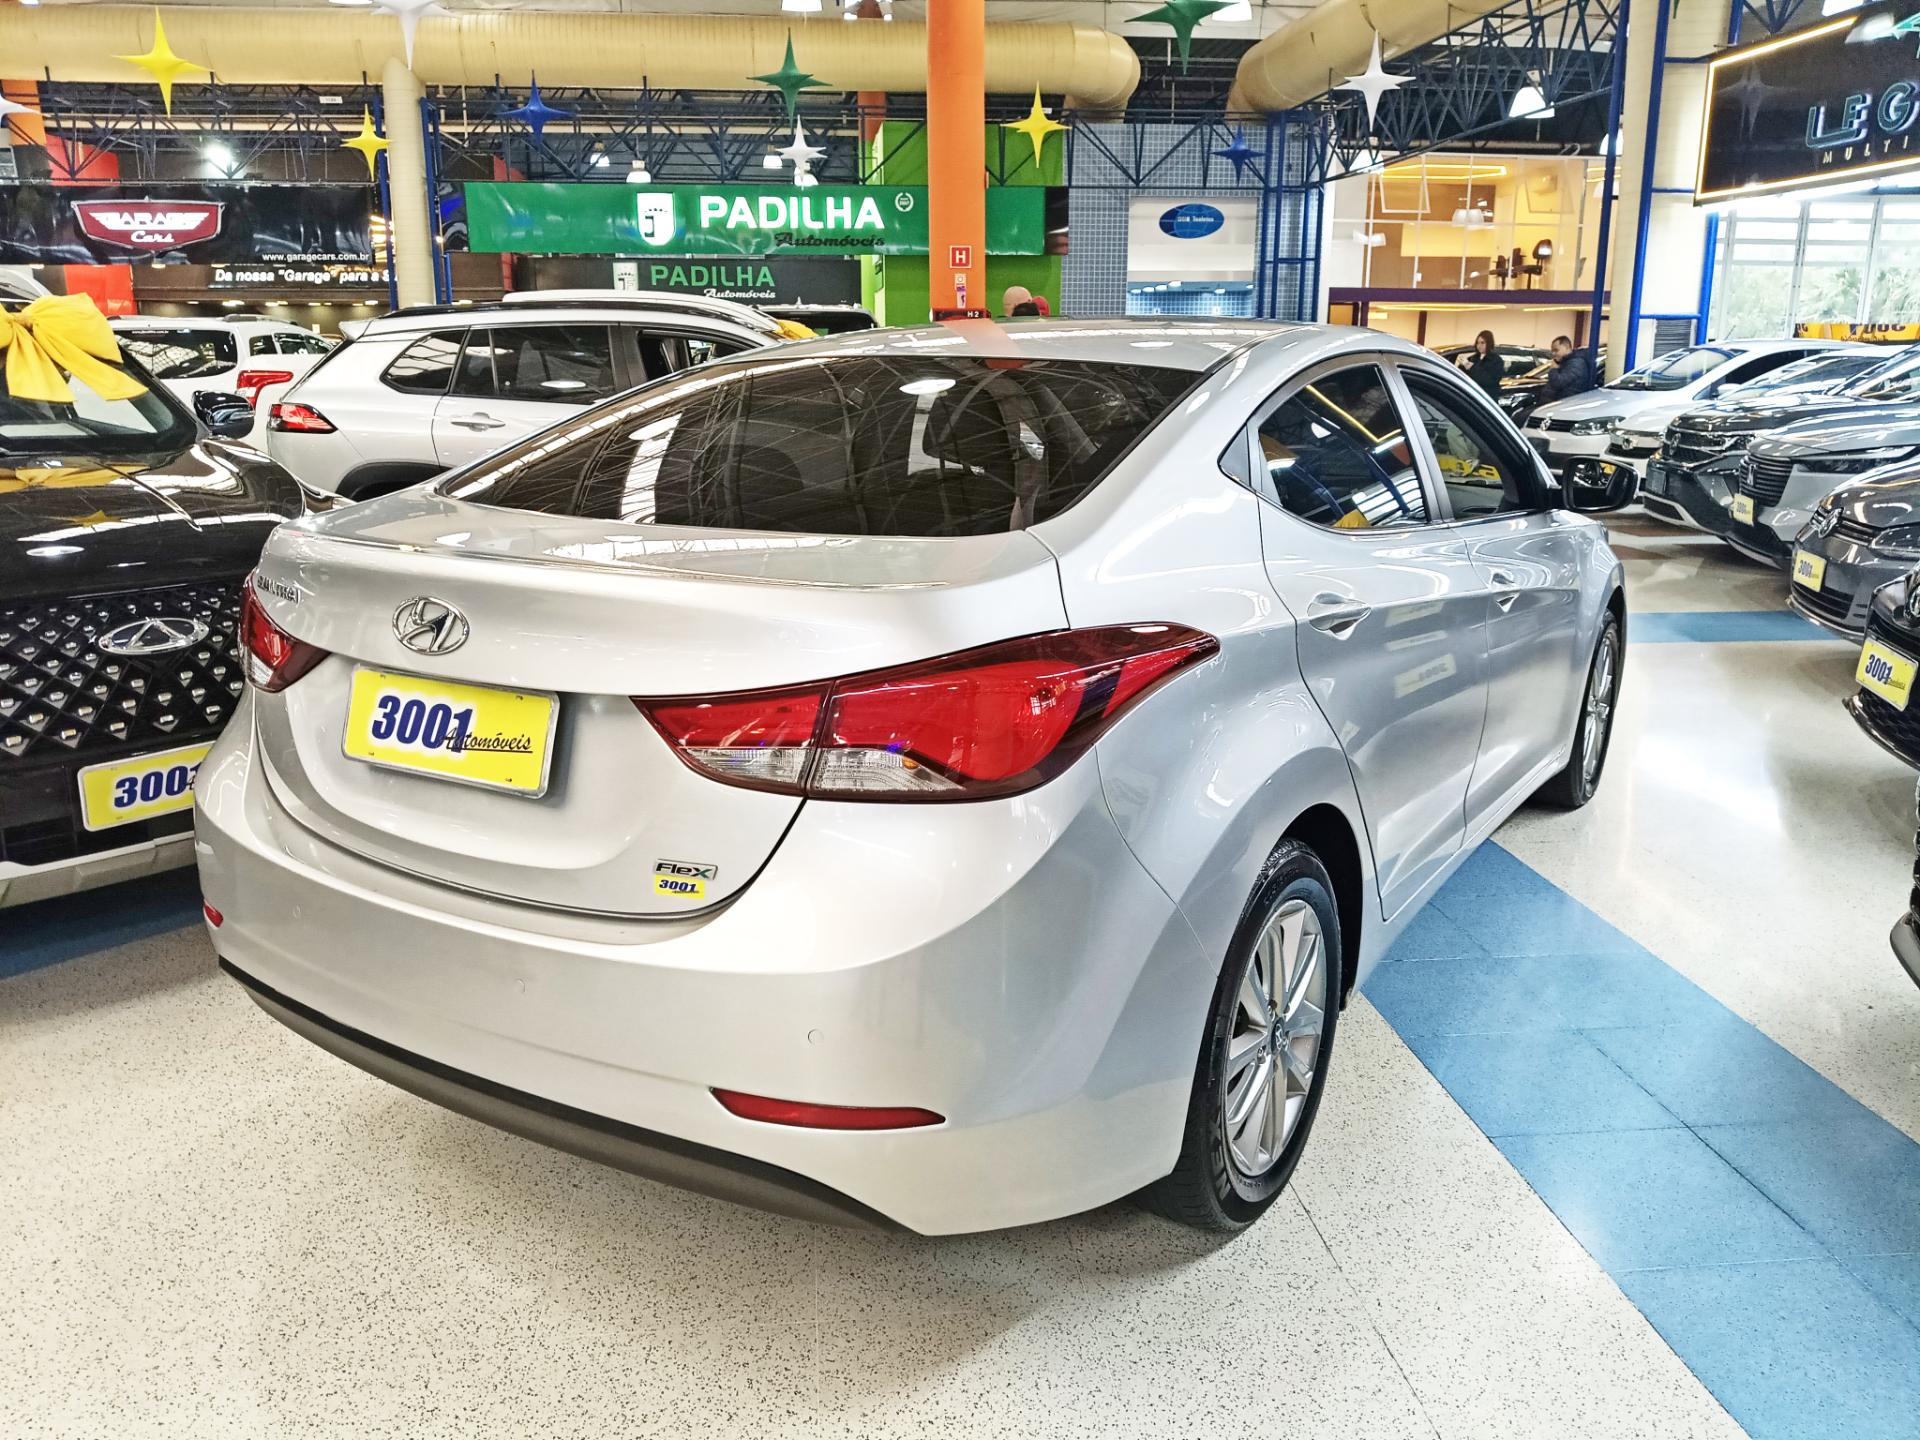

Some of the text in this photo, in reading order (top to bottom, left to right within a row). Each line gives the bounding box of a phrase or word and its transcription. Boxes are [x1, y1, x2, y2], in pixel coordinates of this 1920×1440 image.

[1822, 135, 1909, 164] MULTI
[89, 211, 210, 231] GARAGE
[699, 195, 885, 230] PADILHA
[130, 230, 175, 244] Cars
[775, 231, 886, 249] Automóveis
[262, 253, 370, 263] www.garagecars.com.br
[955, 250, 966, 264] H
[215, 269, 233, 282] Da
[235, 271, 275, 282] nossa
[278, 269, 338, 284] "Garage"
[339, 271, 368, 284] para
[370, 272, 379, 282] a
[650, 263, 776, 288] PADILHA
[703, 287, 776, 299] Automóveis
[1865, 653, 1893, 685] 3001
[371, 694, 533, 754] 3001 Automóveis
[114, 762, 203, 808] 300
[655, 862, 713, 880] Flex
[658, 879, 697, 893] 3001
